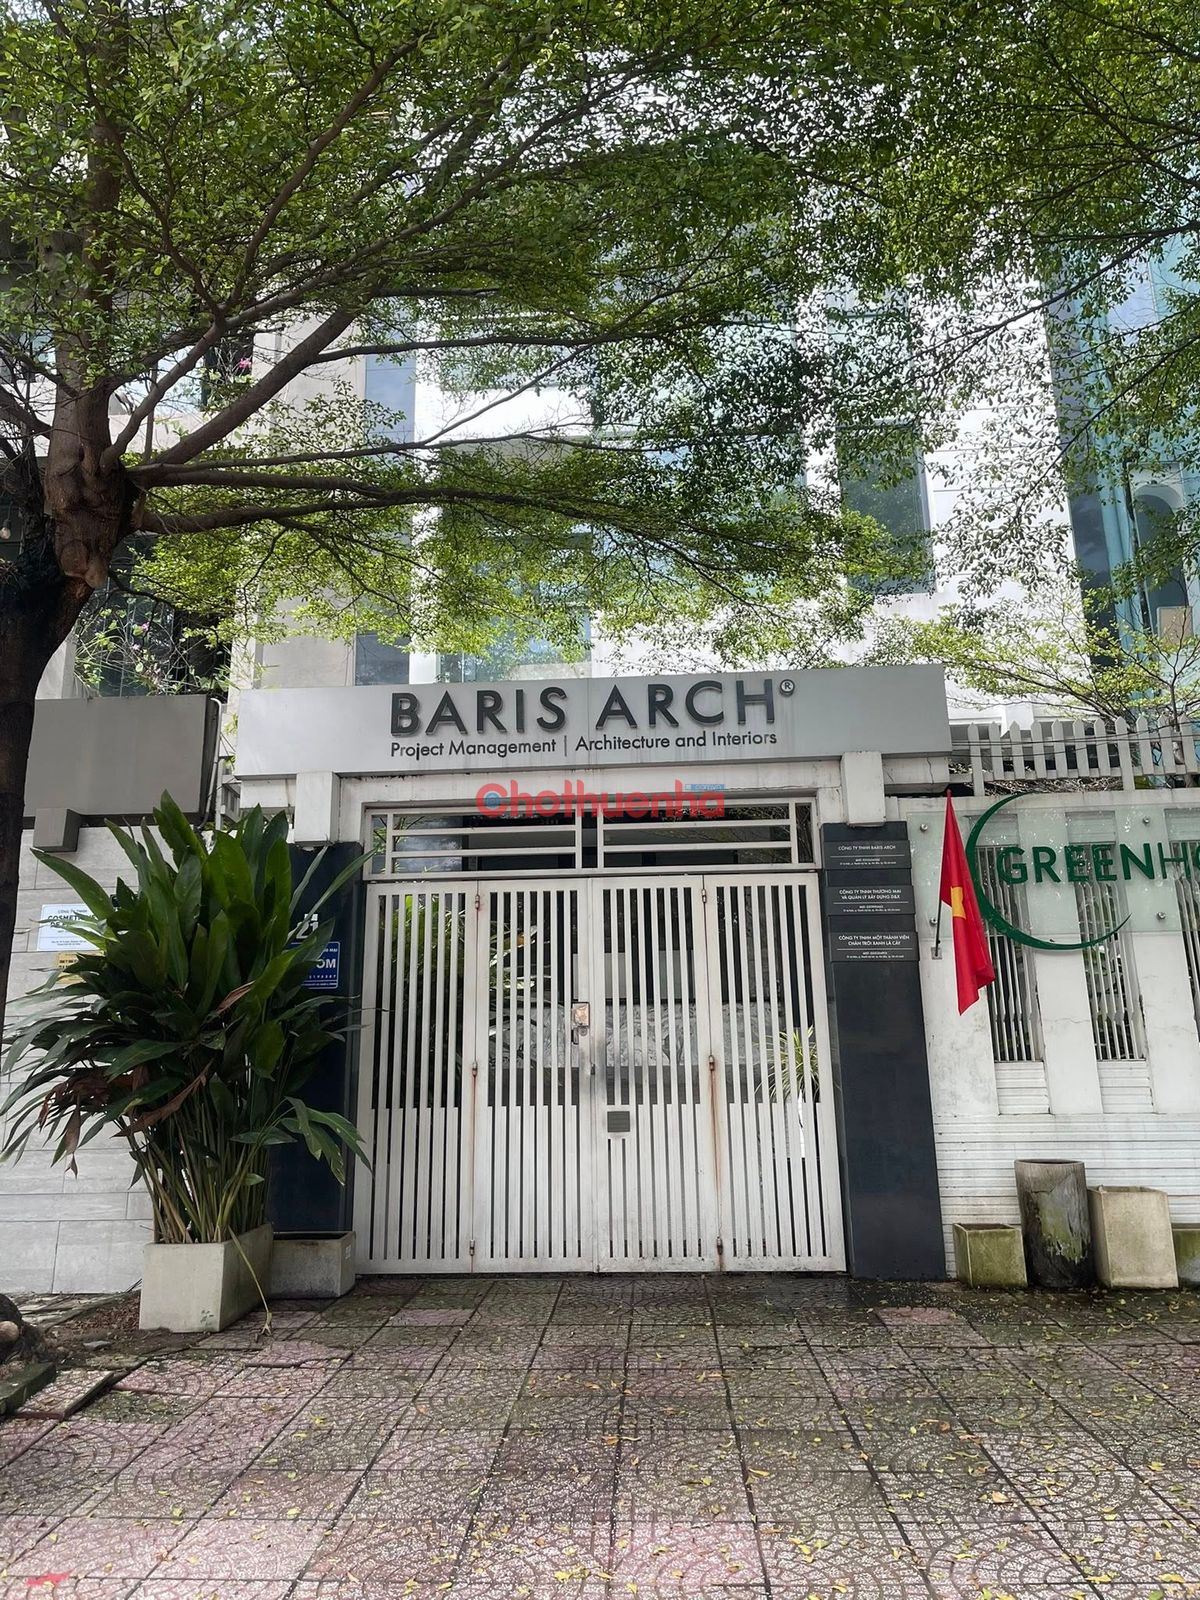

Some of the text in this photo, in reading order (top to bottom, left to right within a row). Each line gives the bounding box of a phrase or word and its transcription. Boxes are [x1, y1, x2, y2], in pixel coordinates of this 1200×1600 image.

[390, 686, 567, 736] BARIS
[391, 731, 777, 760] Project Management Architecture and Interiors
[996, 841, 1200, 884] GREENH
